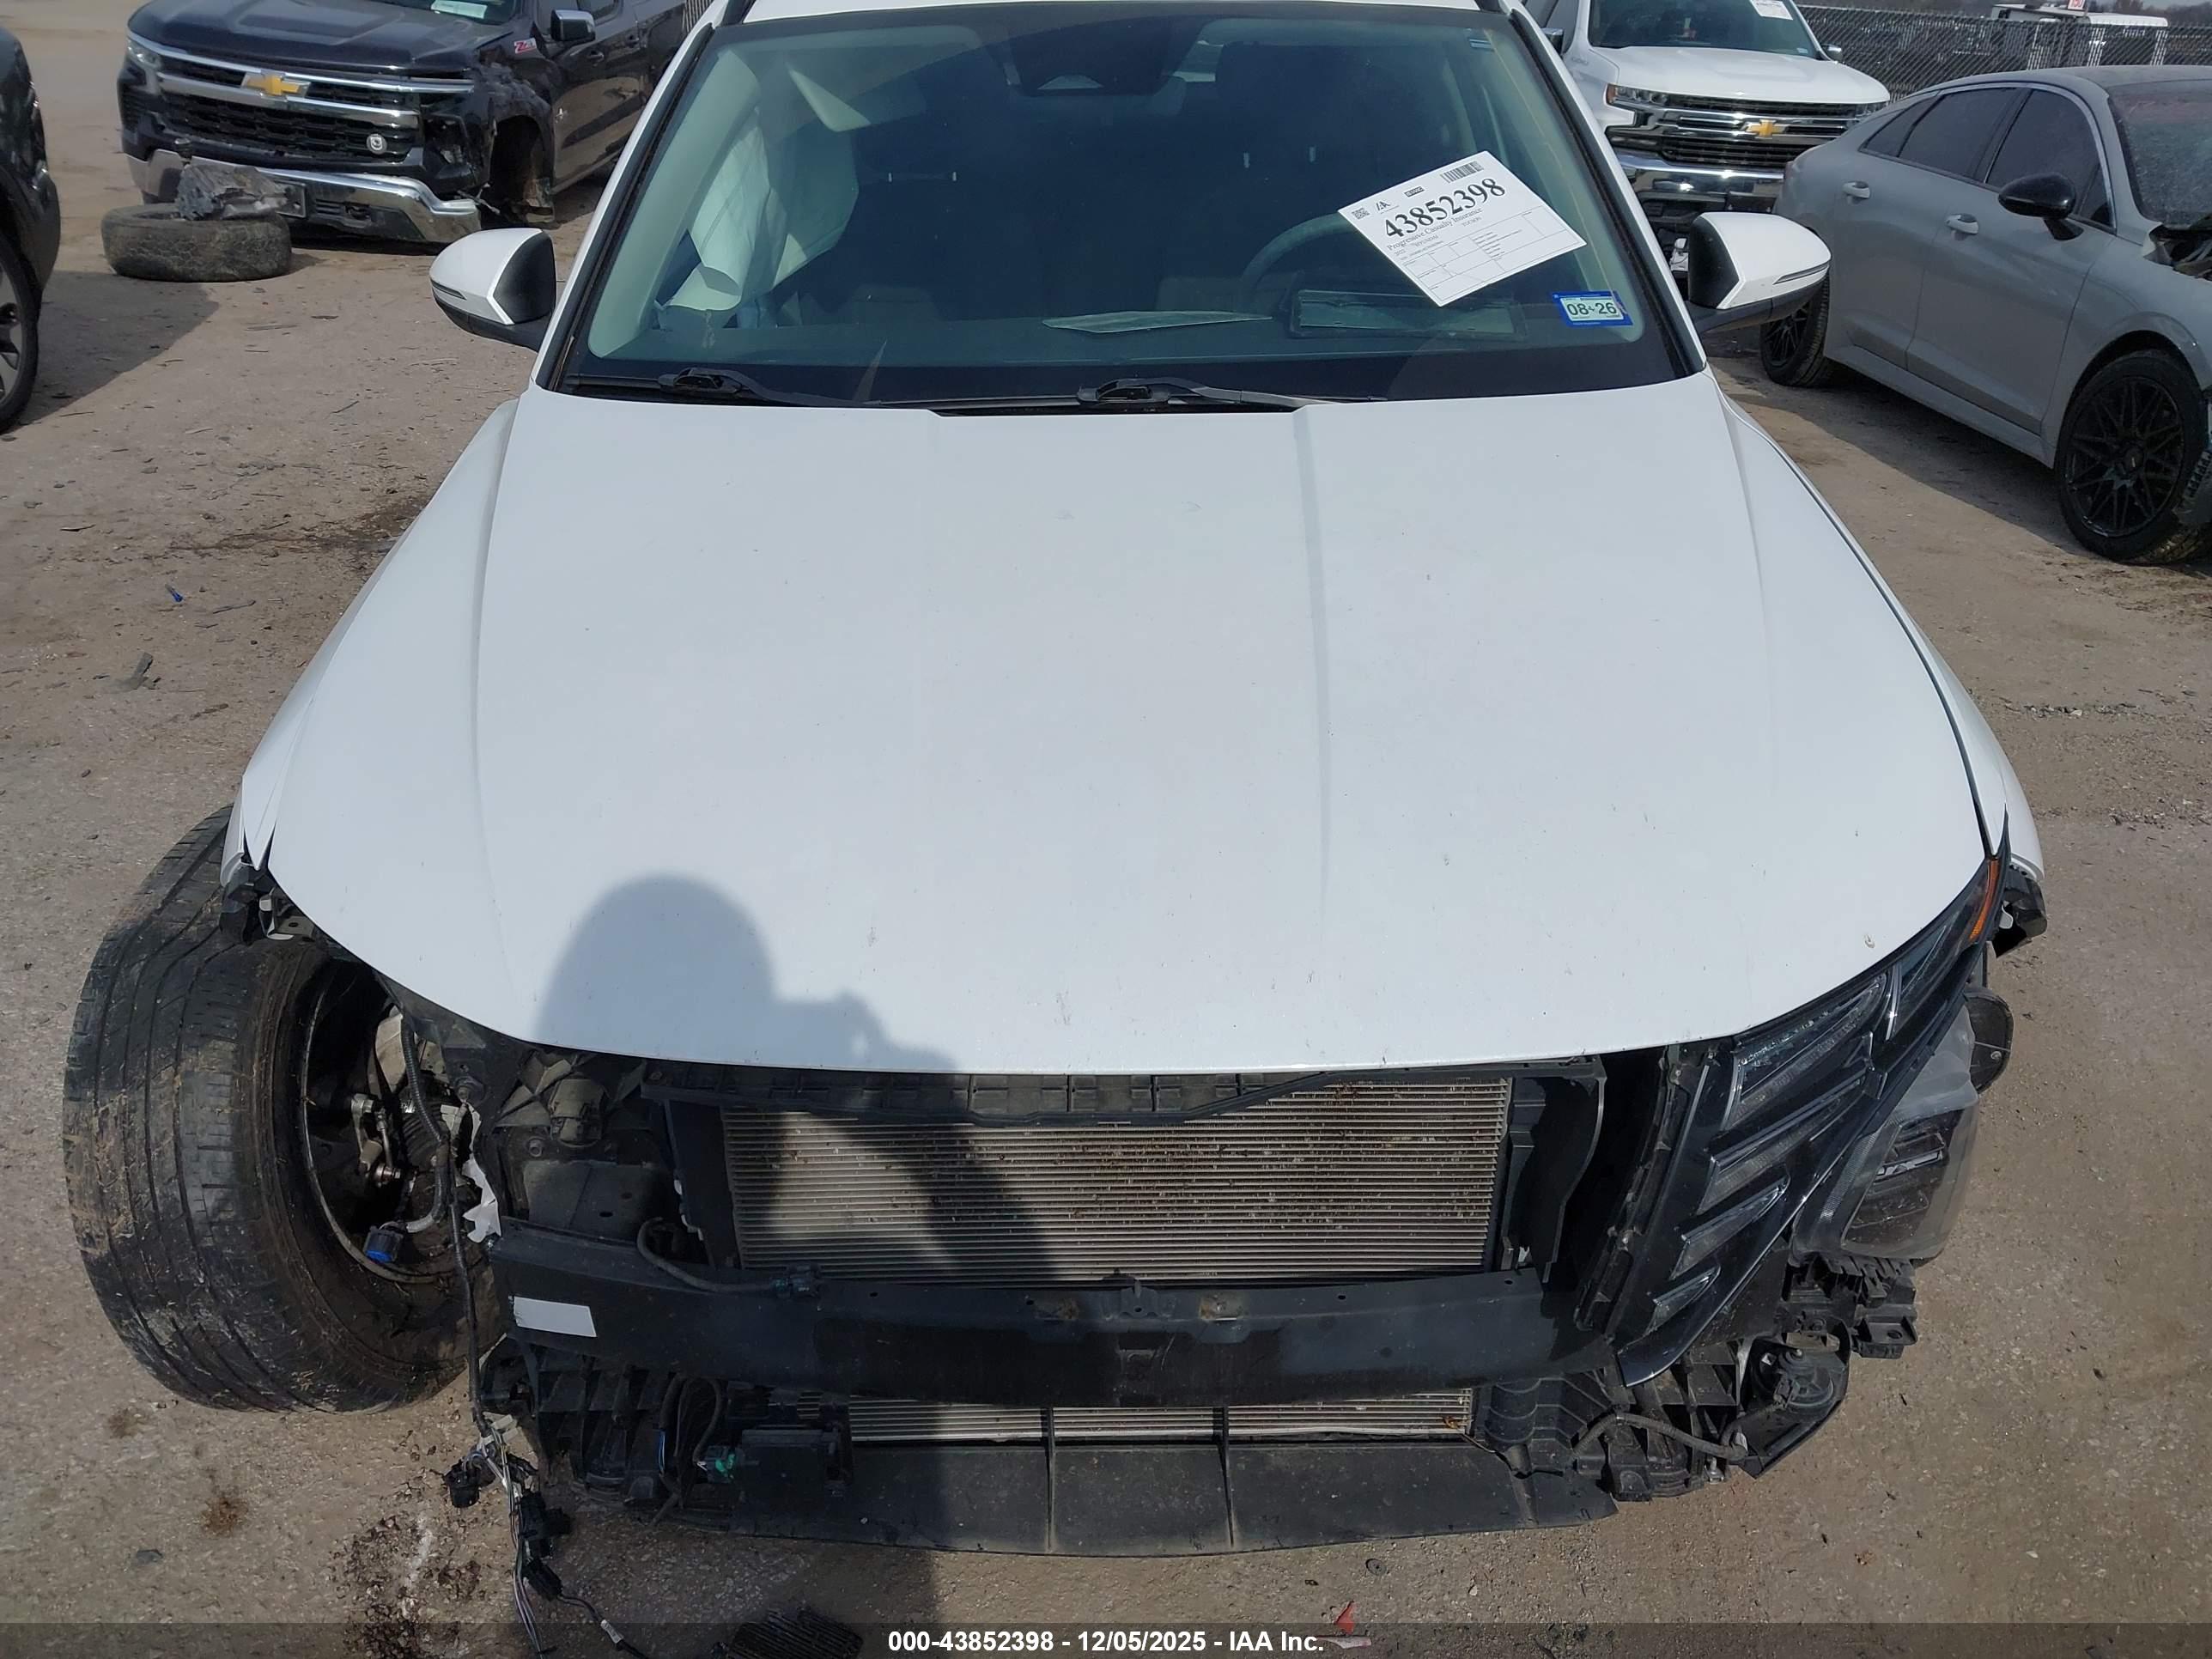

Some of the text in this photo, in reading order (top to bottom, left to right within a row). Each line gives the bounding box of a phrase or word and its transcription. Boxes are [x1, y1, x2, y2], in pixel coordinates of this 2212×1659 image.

[1385, 178, 1505, 237] 43852398
[1425, 221, 1453, 234] Casualty
[1566, 301, 1618, 316] 08 26
